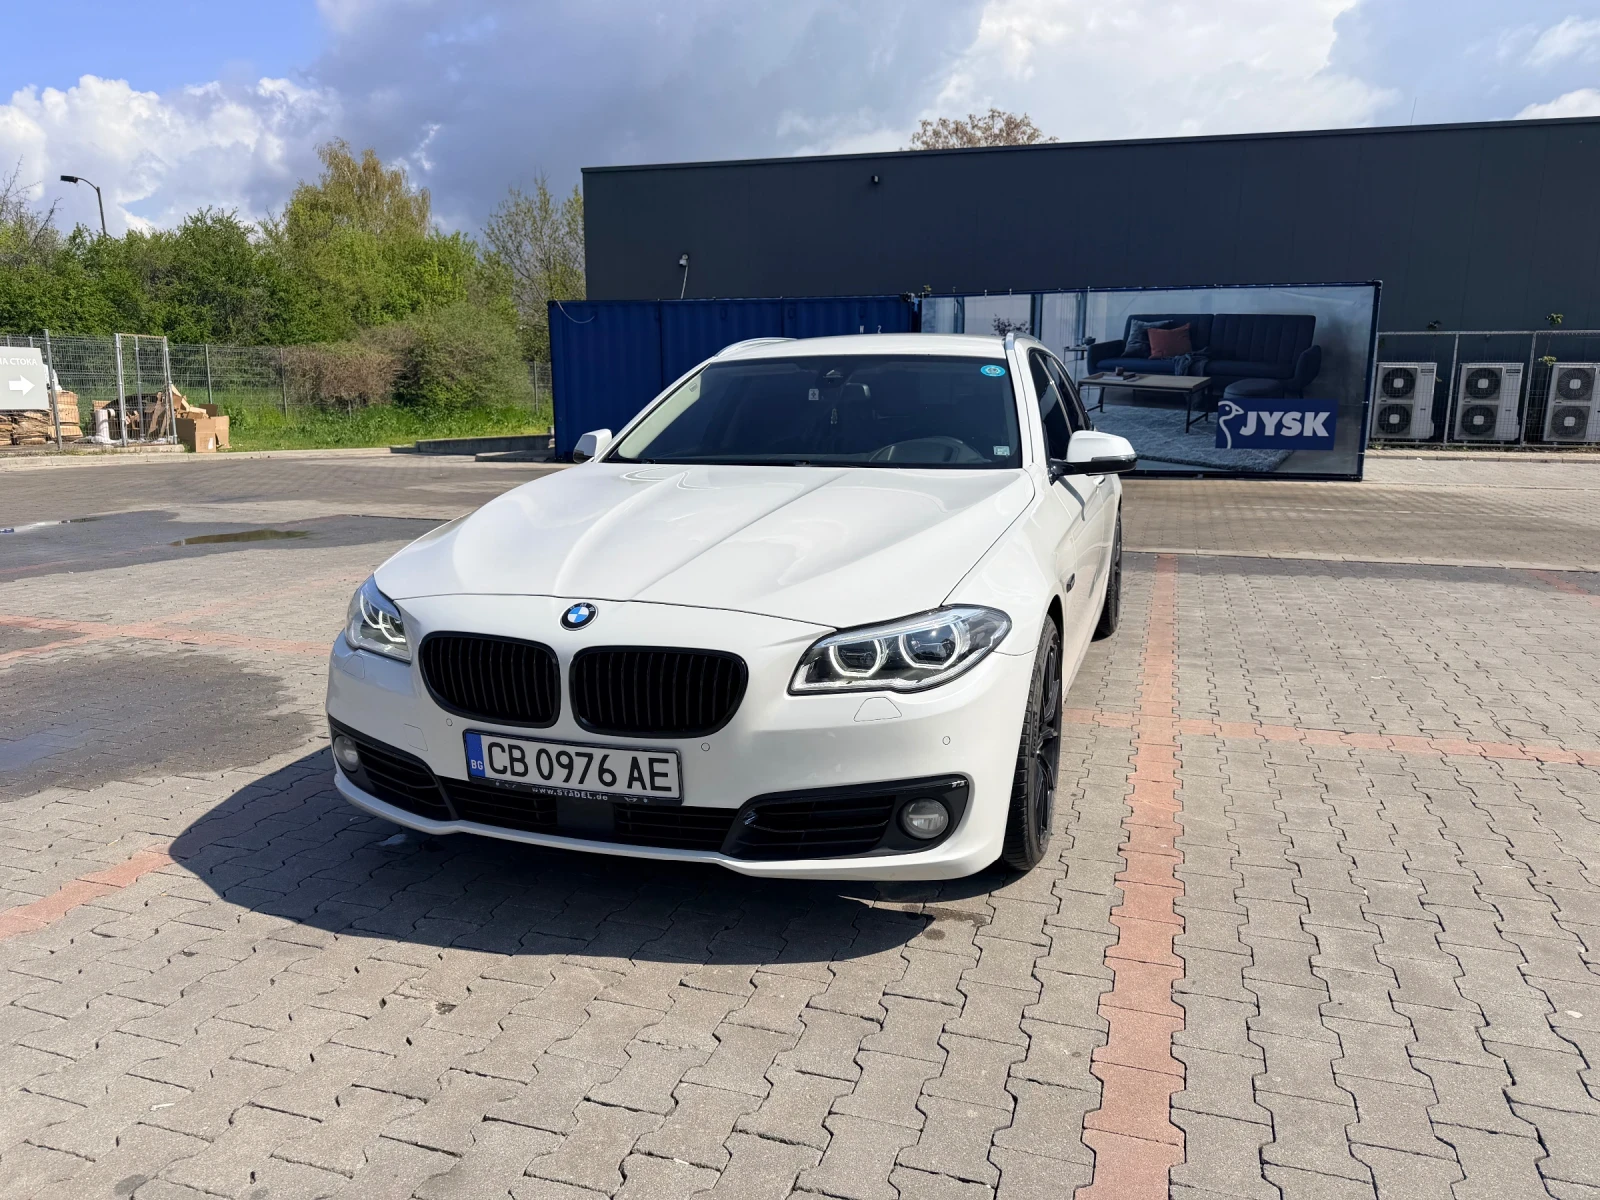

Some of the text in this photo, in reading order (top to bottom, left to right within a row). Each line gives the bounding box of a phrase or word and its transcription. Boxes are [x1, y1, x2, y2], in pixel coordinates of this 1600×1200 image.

[0, 357, 38, 366] А СТОКА
[1239, 411, 1331, 437] JYSK
[470, 759, 484, 770] BG
[488, 742, 672, 792] CB 0976 AE
